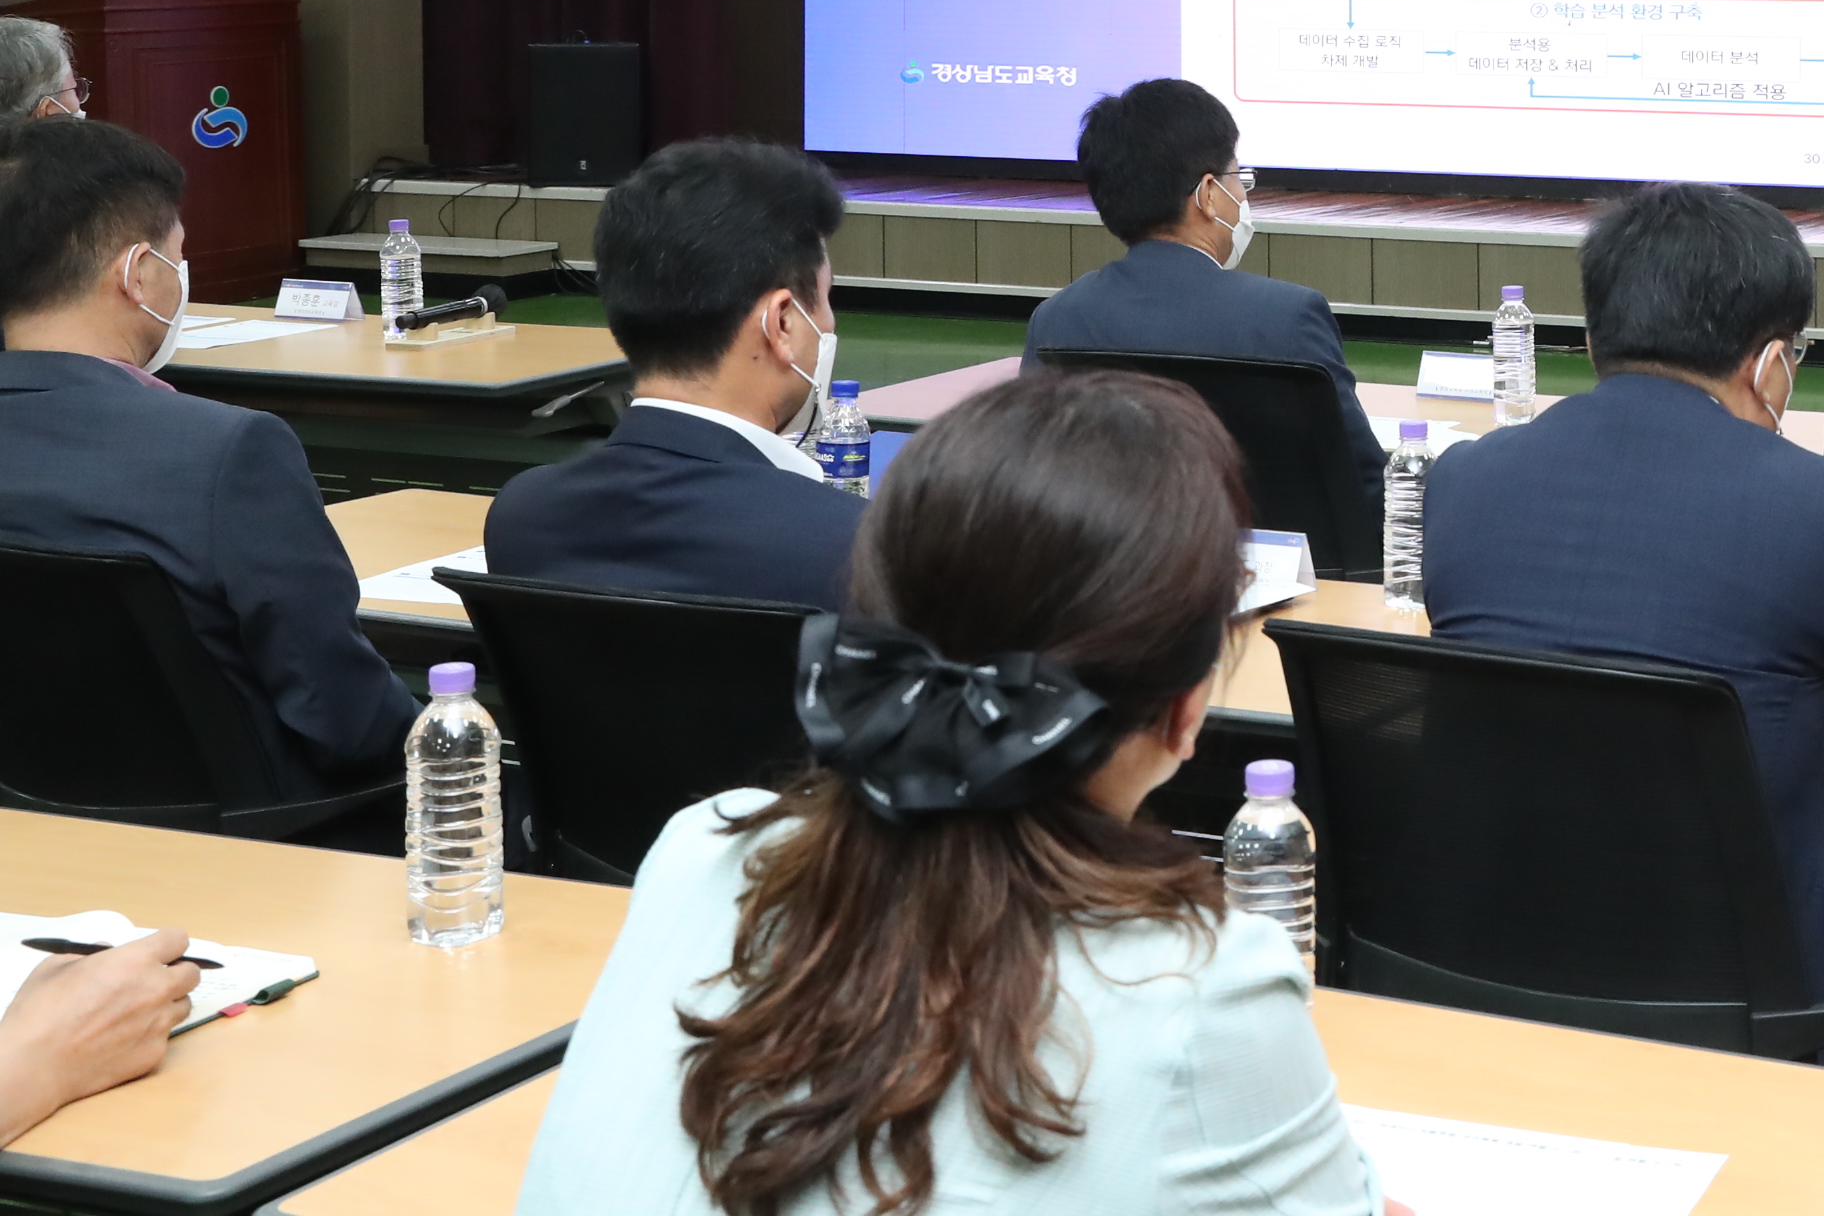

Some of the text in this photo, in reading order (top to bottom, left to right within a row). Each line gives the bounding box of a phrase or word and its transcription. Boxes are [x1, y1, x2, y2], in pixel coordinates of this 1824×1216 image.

[1554, 3, 1703, 21] 학습 분석 환경 구축
[1352, 53, 1379, 68] 개발
[1468, 57, 1510, 71] 데이터
[1681, 49, 1760, 66] 데이터 분석
[931, 63, 1077, 86] 경상남도교육청
[1653, 82, 1787, 101] AI 알고리즘 적용
[1804, 153, 1820, 164] 30
